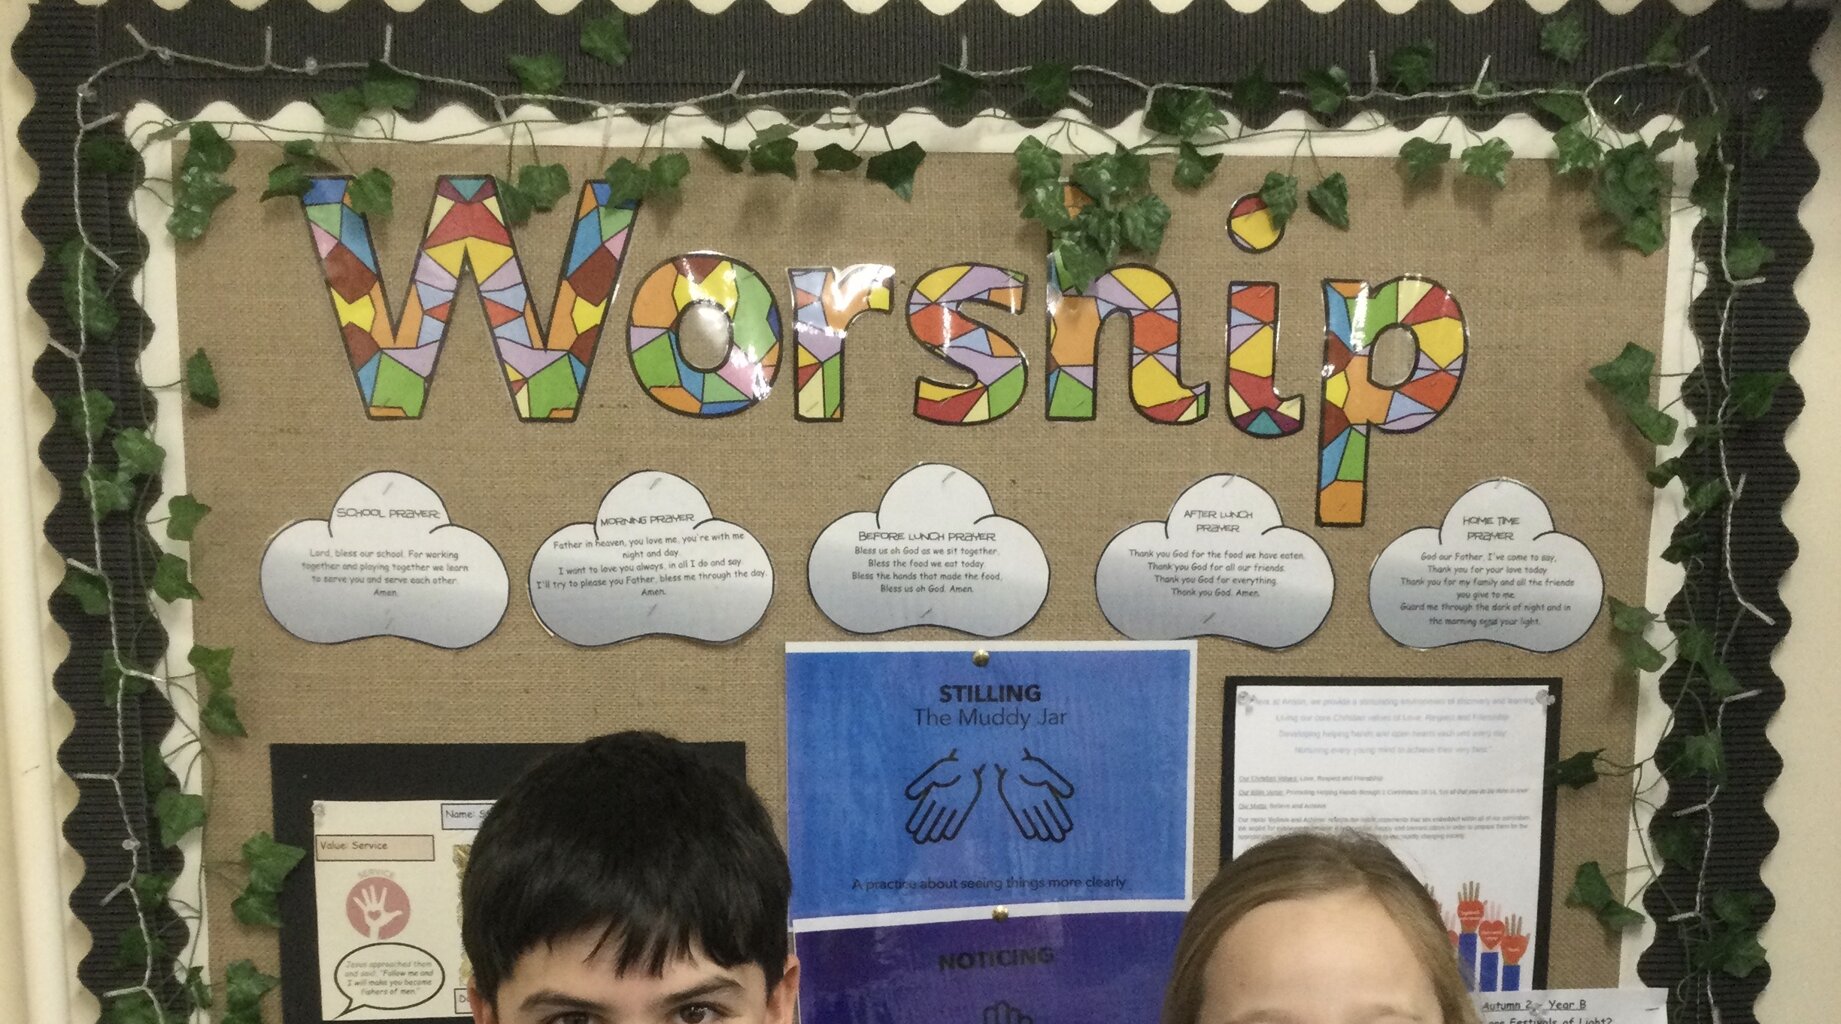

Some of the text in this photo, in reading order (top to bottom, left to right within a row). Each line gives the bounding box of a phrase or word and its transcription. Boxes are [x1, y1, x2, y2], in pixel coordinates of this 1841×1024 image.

[302, 175, 1470, 527] Worship
[337, 508, 385, 518] SCHOOL
[1184, 510, 1253, 519] AFTER LUNCH
[601, 514, 695, 526] MORNING PRAYER
[1463, 517, 1520, 525] HOME TIME
[1196, 524, 1240, 532] PRAYER
[554, 541, 582, 549] Father
[586, 540, 592, 548] in
[629, 539, 643, 547] you
[682, 534, 709, 544] you're
[712, 533, 729, 541] with
[859, 532, 996, 541] BEFORE LUNCH PRAYER
[1467, 532, 1514, 540] PRAYER
[335, 549, 357, 557] bless
[426, 551, 458, 560] working
[623, 550, 643, 560] night
[647, 550, 661, 558] and
[855, 547, 876, 555] Bless
[891, 547, 900, 555] oh
[903, 547, 919, 555] God
[947, 547, 958, 555] sit
[1129, 549, 1153, 557] Thank
[1156, 551, 1171, 559] you
[1173, 550, 1188, 558] God
[1192, 550, 1205, 558] for
[1224, 551, 1242, 559] food
[559, 567, 563, 575] I
[566, 567, 586, 575] want
[589, 566, 598, 574] to
[601, 565, 617, 573] love
[620, 565, 634, 573] you
[691, 560, 695, 568] I
[711, 559, 725, 567] and
[868, 559, 890, 567] Bless
[893, 559, 906, 567] the
[910, 559, 928, 567] food
[961, 560, 984, 569] today
[1148, 562, 1171, 570] Thank
[1174, 564, 1189, 572] you
[1191, 563, 1207, 571] God
[1210, 563, 1224, 571] for
[1226, 563, 1235, 571] all
[1428, 565, 1452, 573] Thank
[1454, 566, 1468, 575] you
[1486, 567, 1504, 575] your
[1506, 566, 1522, 574] love
[537, 581, 550, 589] I'll
[553, 580, 566, 589] try
[581, 579, 606, 587] please
[609, 579, 623, 587] you
[660, 574, 681, 582] bless
[699, 571, 732, 581] through
[735, 570, 748, 578] the
[751, 570, 767, 578] day.
[877, 572, 890, 580] the
[893, 572, 917, 580] hands
[920, 572, 937, 580] that
[940, 572, 962, 580] made
[1155, 575, 1179, 583] Thank
[1182, 576, 1196, 585] you
[1217, 576, 1230, 584] for
[928, 585, 946, 593] God.
[950, 585, 974, 593] Amen.
[1199, 589, 1212, 597] you
[1236, 589, 1260, 597] Amen.
[939, 684, 1041, 703] STILLING
[914, 708, 1067, 730] The Muddy Jar
[352, 841, 388, 850] Service
[852, 876, 1126, 891] A practice about seeing things more clearly
[938, 947, 1055, 970] NOTICING
[1483, 1000, 1586, 1011] Autumn 2 Year B
